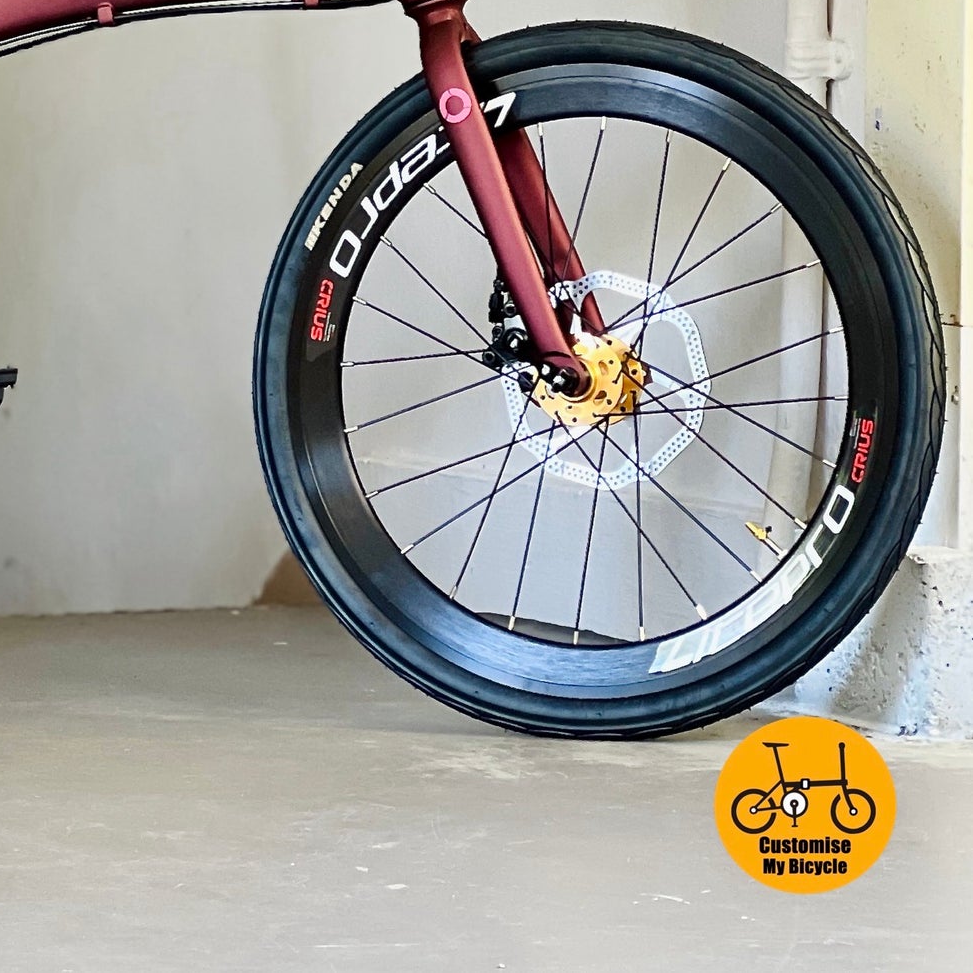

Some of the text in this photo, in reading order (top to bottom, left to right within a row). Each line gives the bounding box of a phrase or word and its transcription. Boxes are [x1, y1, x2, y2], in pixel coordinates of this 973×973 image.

[308, 162, 364, 241] KENDA
[310, 279, 334, 342] CRIUS
[851, 418, 875, 484] CRIUS
